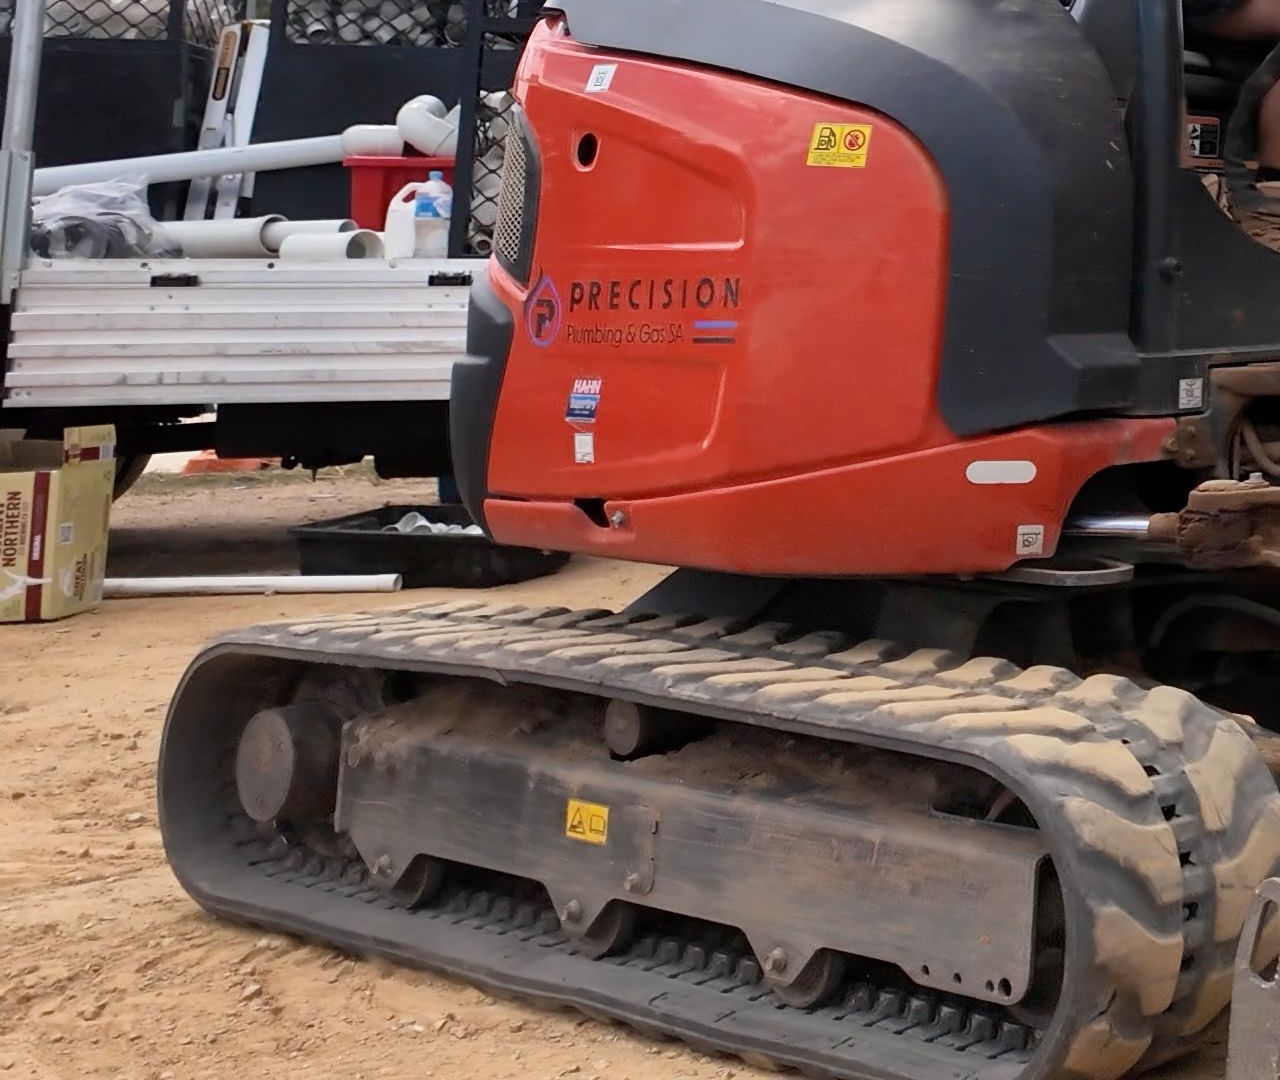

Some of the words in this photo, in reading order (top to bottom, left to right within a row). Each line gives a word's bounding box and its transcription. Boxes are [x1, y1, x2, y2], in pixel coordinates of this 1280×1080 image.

[568, 276, 741, 313] PRECISION
[567, 323, 622, 348] Plumbing
[626, 323, 637, 344] &
[640, 323, 664, 344] Gas
[667, 323, 683, 344] SA
[572, 379, 602, 394] HAHN
[1, 491, 22, 569] NORTHERN
